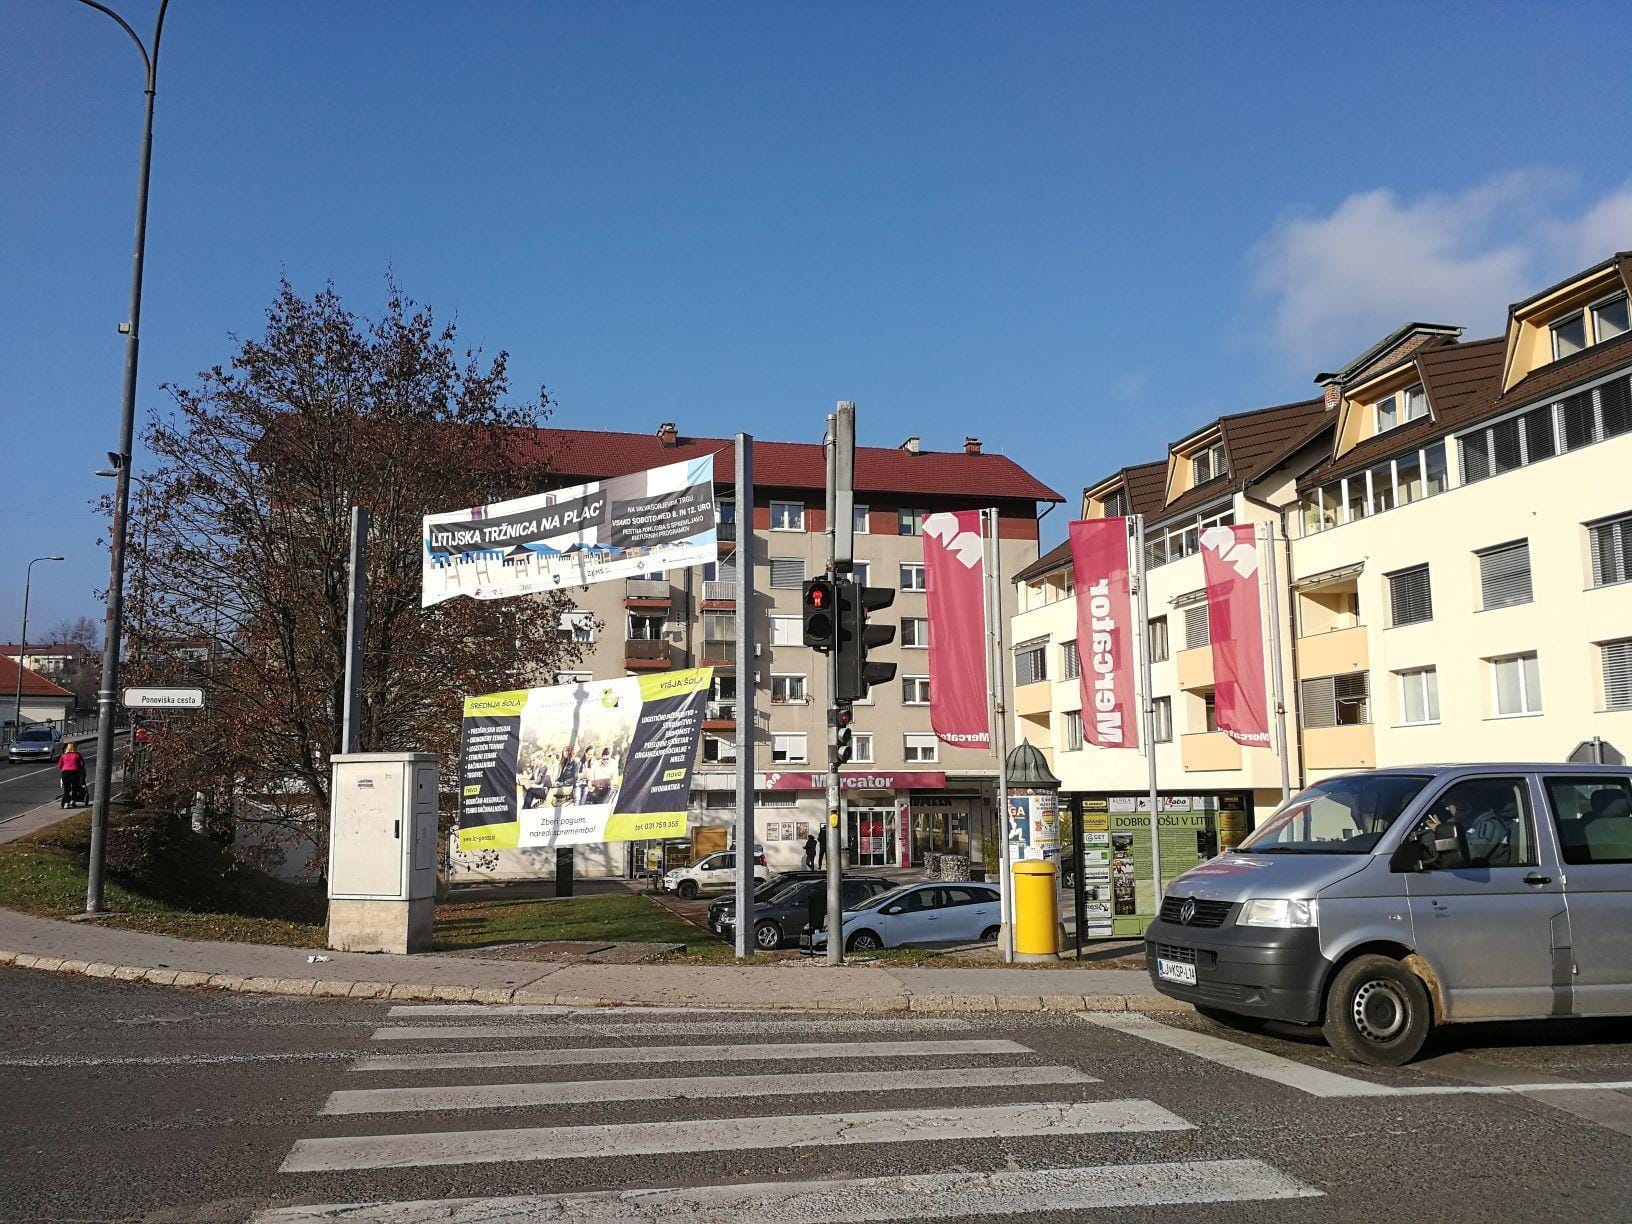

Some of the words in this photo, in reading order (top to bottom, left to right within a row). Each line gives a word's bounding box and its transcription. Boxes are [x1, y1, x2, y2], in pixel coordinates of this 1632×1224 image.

[678, 494, 694, 504] TRGU
[612, 518, 631, 526] VSAKO
[632, 514, 658, 525] SOBOTO
[688, 506, 697, 514] 12.
[698, 502, 711, 512] URO
[432, 530, 481, 547] LITIJSKA
[484, 520, 538, 543] TRŽNICA
[540, 514, 560, 530] NA
[660, 680, 683, 689] VIŠJA
[683, 676, 704, 686] ŠOLA
[176, 696, 196, 704] cesta
[470, 702, 500, 710] SREDNJA
[811, 774, 894, 788] Mrcator
[540, 818, 558, 826] Zberi
[644, 822, 655, 830] 031
[668, 820, 679, 828] 355
[1116, 814, 1179, 827] DOBROOŠLI
[1180, 816, 1190, 826] V
